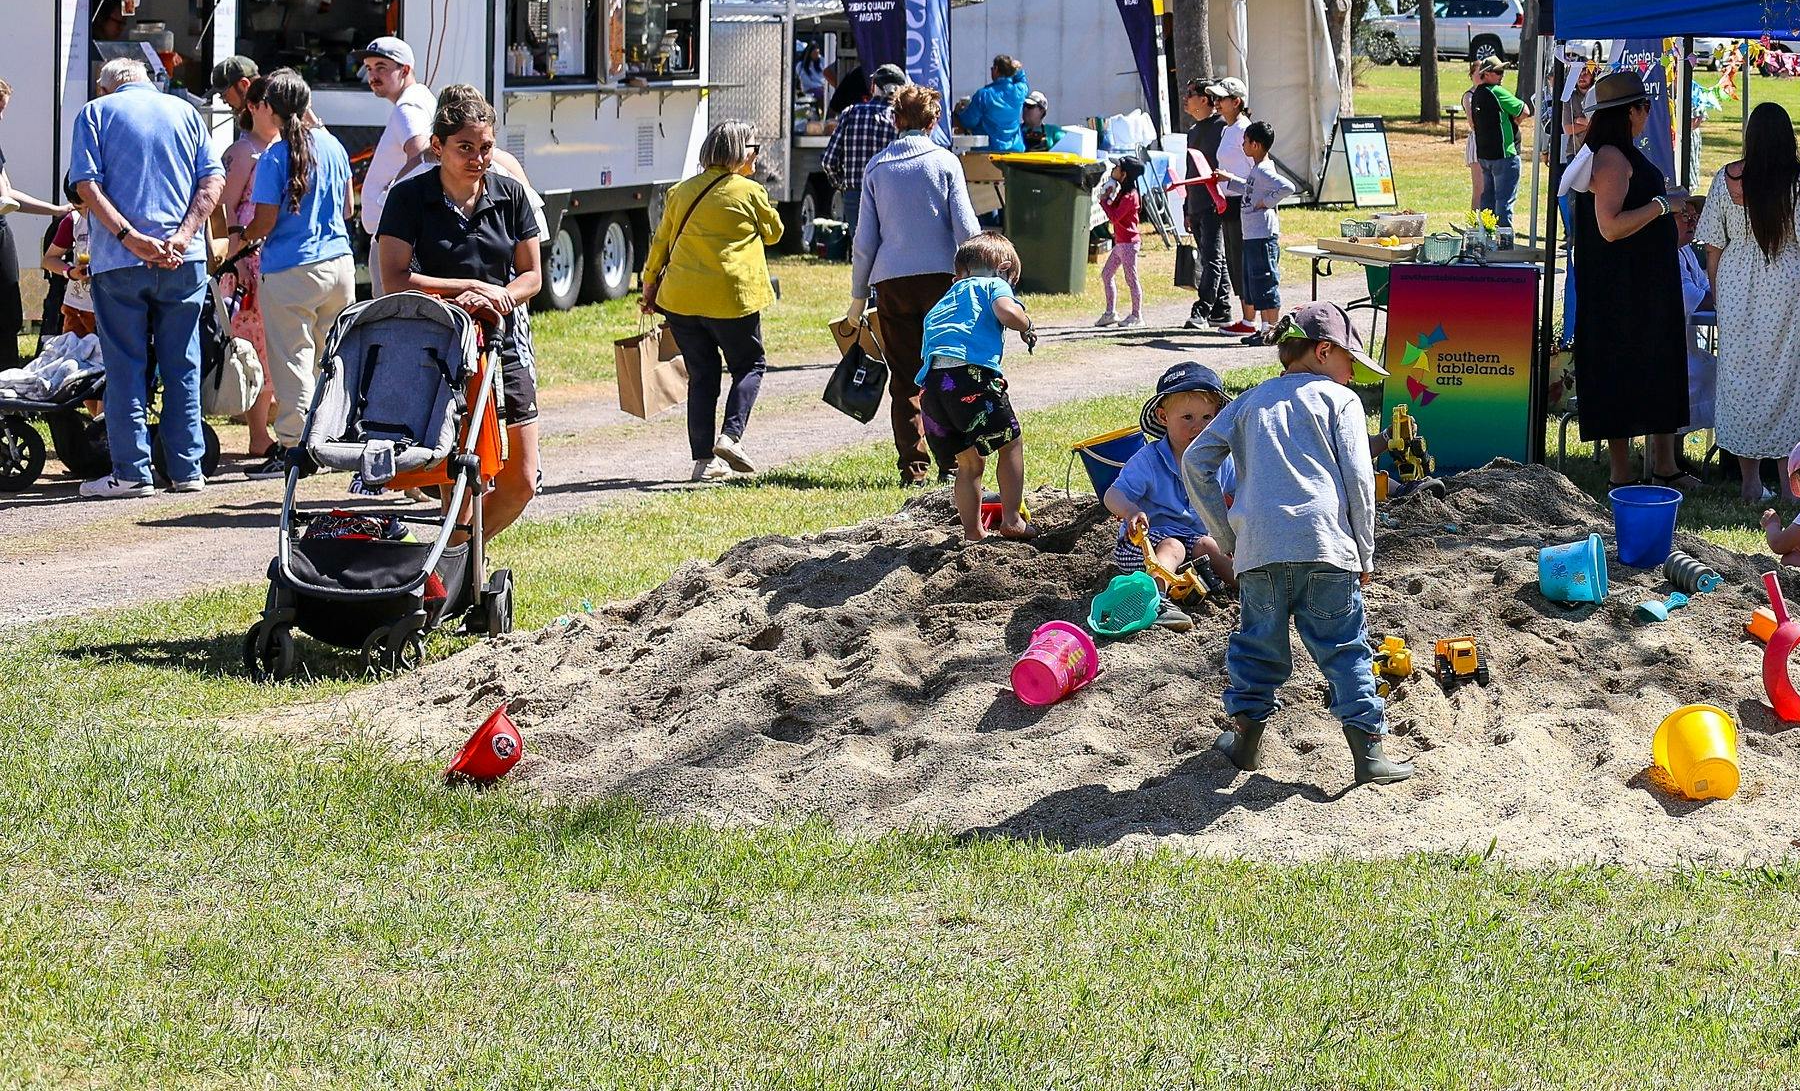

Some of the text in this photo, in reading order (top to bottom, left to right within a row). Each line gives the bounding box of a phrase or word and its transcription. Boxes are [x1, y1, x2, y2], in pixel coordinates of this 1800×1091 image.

[867, 1, 895, 12] QUALITY
[859, 12, 882, 22] MEATS
[1438, 352, 1500, 363] southern
[1437, 363, 1515, 375] tablelands
[1436, 375, 1463, 386] arts
